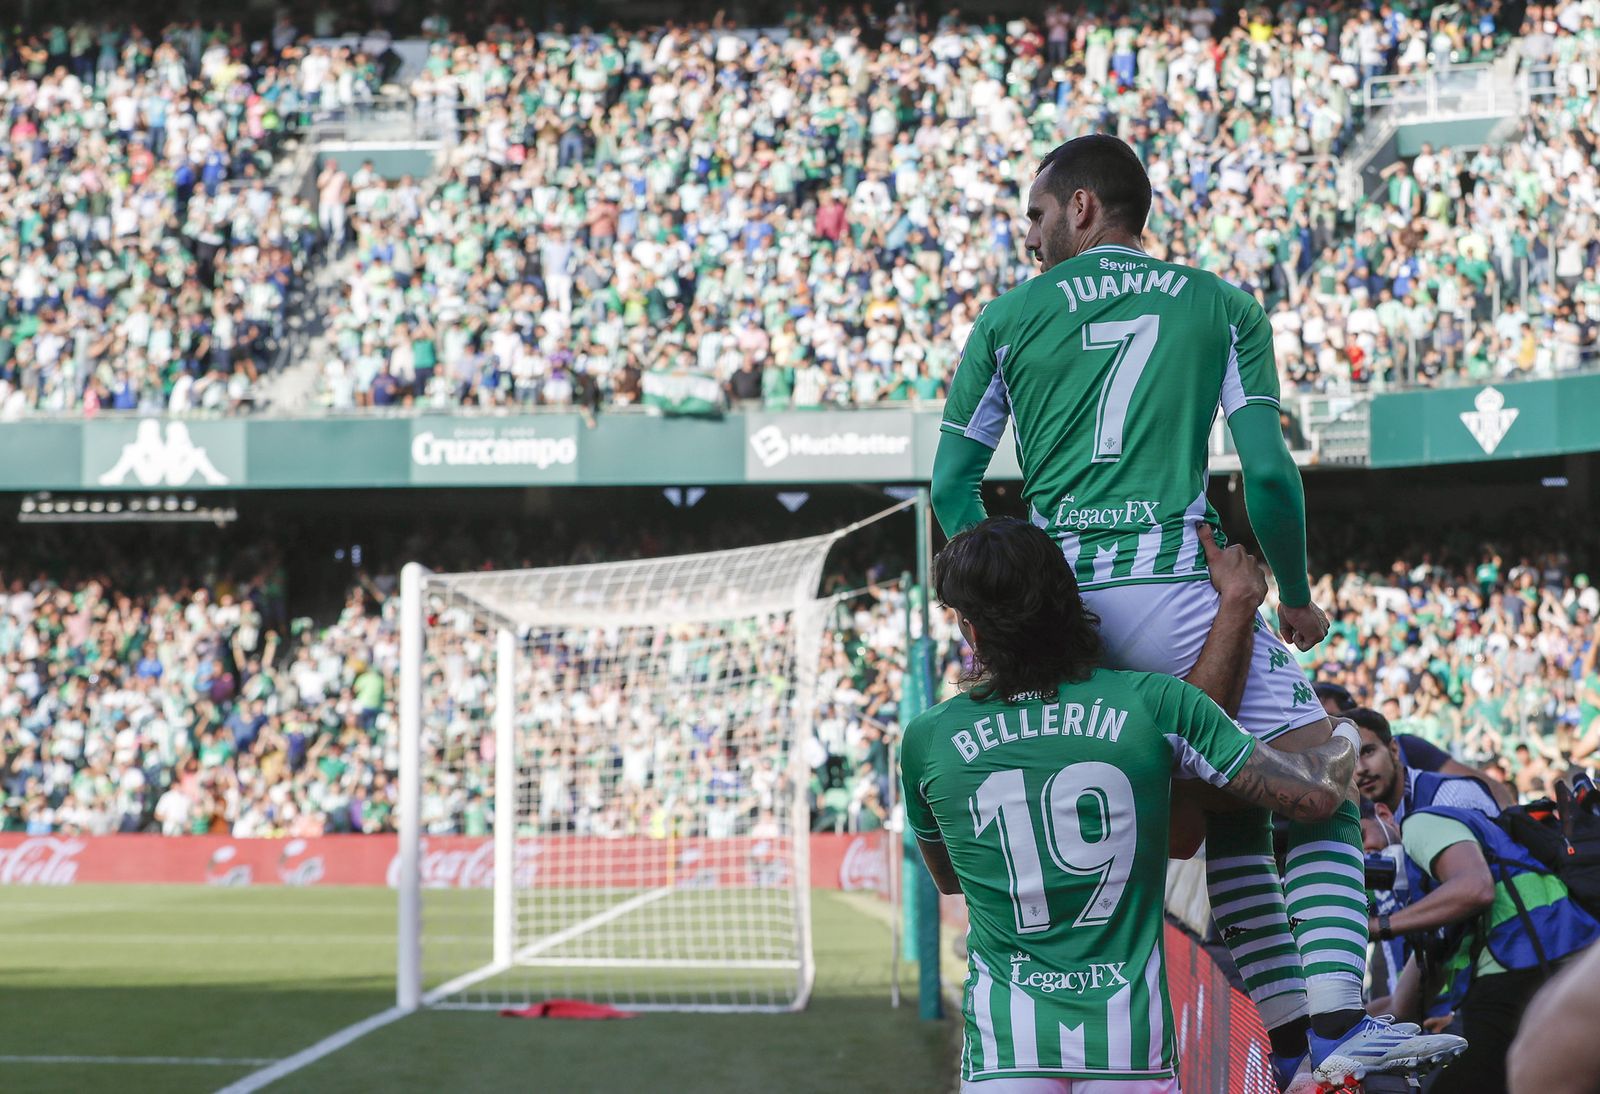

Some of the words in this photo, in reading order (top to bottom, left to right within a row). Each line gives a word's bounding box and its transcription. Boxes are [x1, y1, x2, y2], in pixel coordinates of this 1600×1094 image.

[1056, 270, 1188, 312] JUANMI
[1082, 315, 1160, 463] 7
[411, 431, 577, 469] Cruzcampo
[790, 432, 910, 456] MuchBetter
[1055, 500, 1160, 530] LegacyFX
[951, 698, 1128, 763] BELLERÍN
[969, 761, 1137, 934] 19
[1010, 961, 1130, 994] LegacyFX
